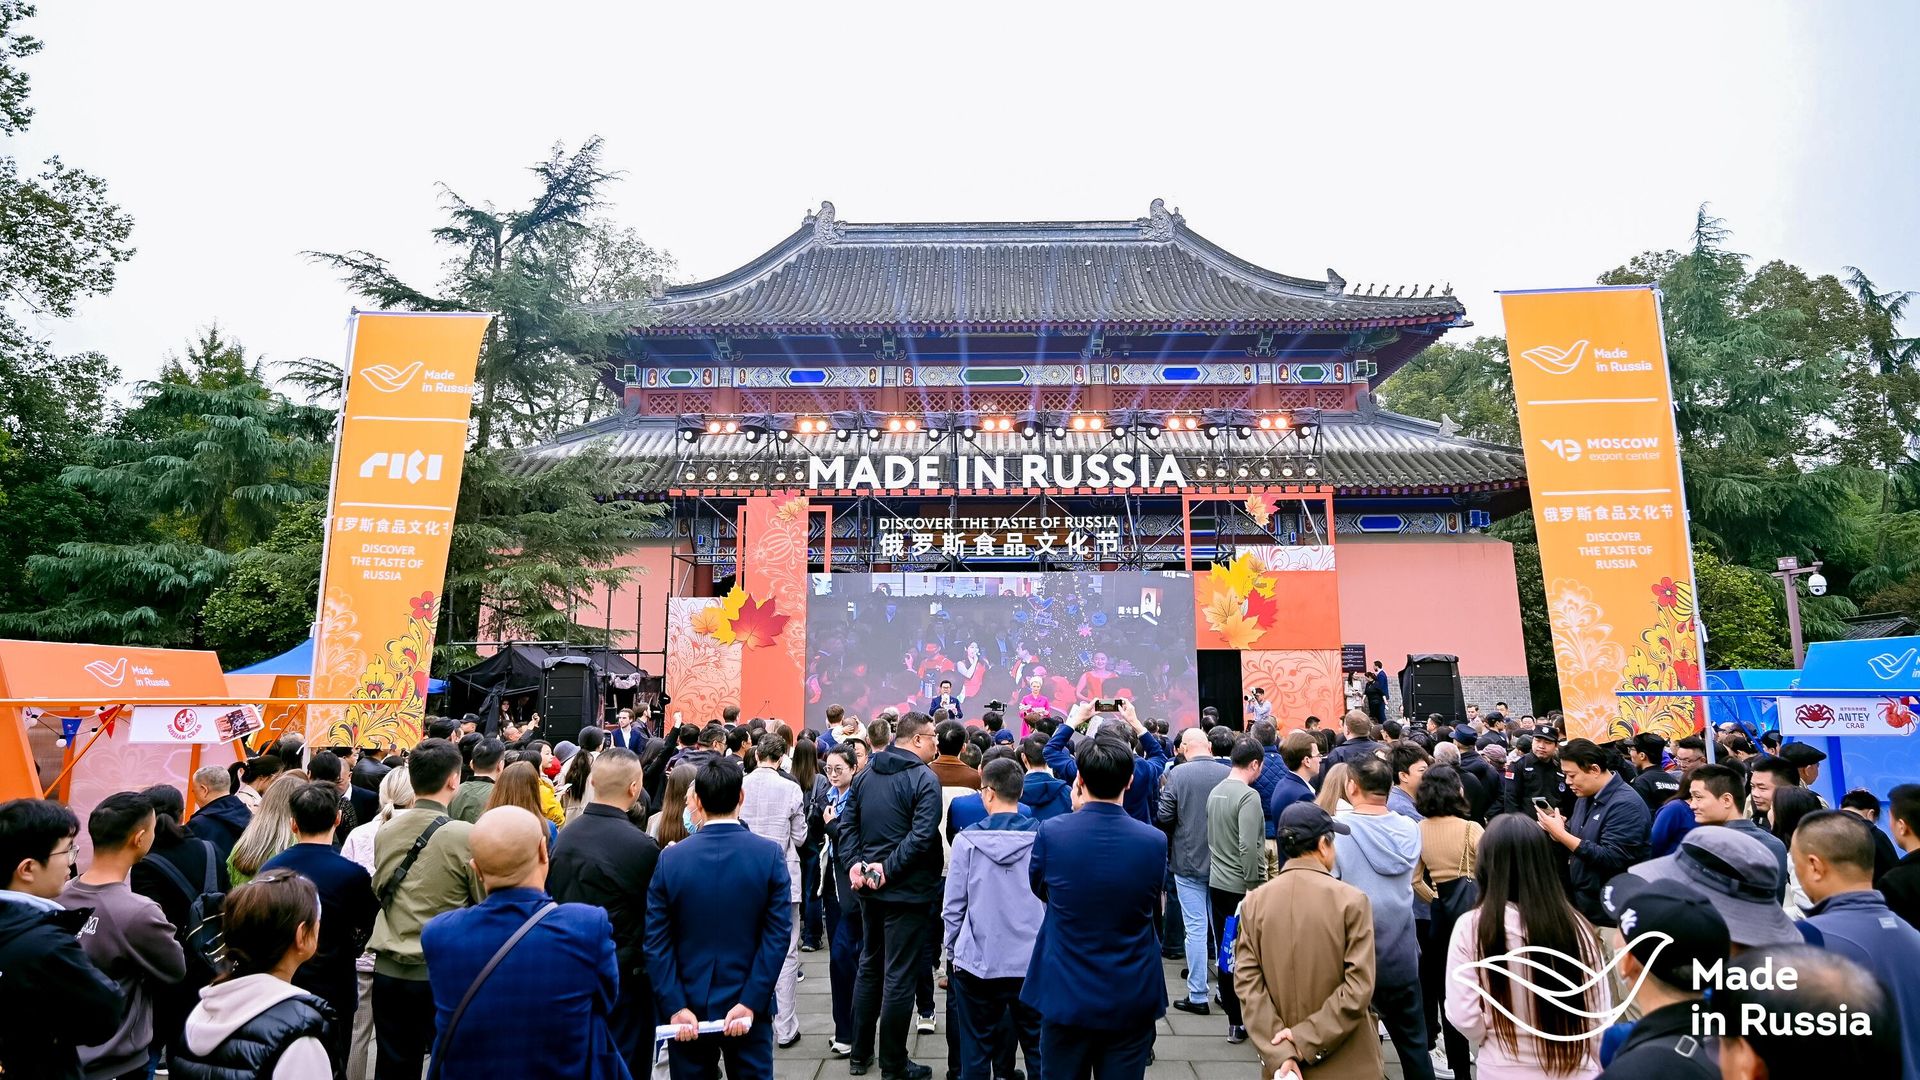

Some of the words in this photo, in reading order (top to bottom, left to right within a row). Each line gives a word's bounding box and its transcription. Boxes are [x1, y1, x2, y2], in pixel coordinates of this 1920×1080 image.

[1594, 348, 1627, 359] Made
[1596, 362, 1608, 372] in
[1610, 361, 1652, 371] Russia
[425, 370, 455, 380] Made
[422, 383, 432, 392] in
[435, 382, 473, 394] Russia
[1587, 438, 1658, 449] MOSCOW
[1589, 453, 1623, 462] export
[1626, 452, 1660, 461] center
[809, 455, 940, 489] MADE
[958, 455, 1004, 489] IN
[1022, 454, 1187, 489] RUSSIA
[1543, 504, 1673, 522] 俄罗斯食品文化节
[879, 518, 953, 530] DISCOVER
[960, 518, 988, 529] THE
[992, 517, 1036, 529] TASTE
[1040, 516, 1060, 528] OF
[1065, 516, 1118, 528] RUSSIA
[1586, 532, 1641, 542] DISCOVER
[361, 544, 415, 555] DISCOVER
[879, 531, 1119, 557] 俄罗斯食品文化节
[1578, 547, 1601, 556] THE
[1603, 546, 1636, 555] TASTE
[1638, 546, 1653, 555] OF
[351, 556, 371, 566] THE
[374, 557, 405, 567] TASTE
[408, 559, 424, 568] OF
[1595, 559, 1638, 569] RUSSIA
[363, 570, 401, 580] RUSSIA
[132, 665, 154, 675] Made
[144, 677, 170, 687] Russia
[1838, 713, 1870, 722] ANTEY
